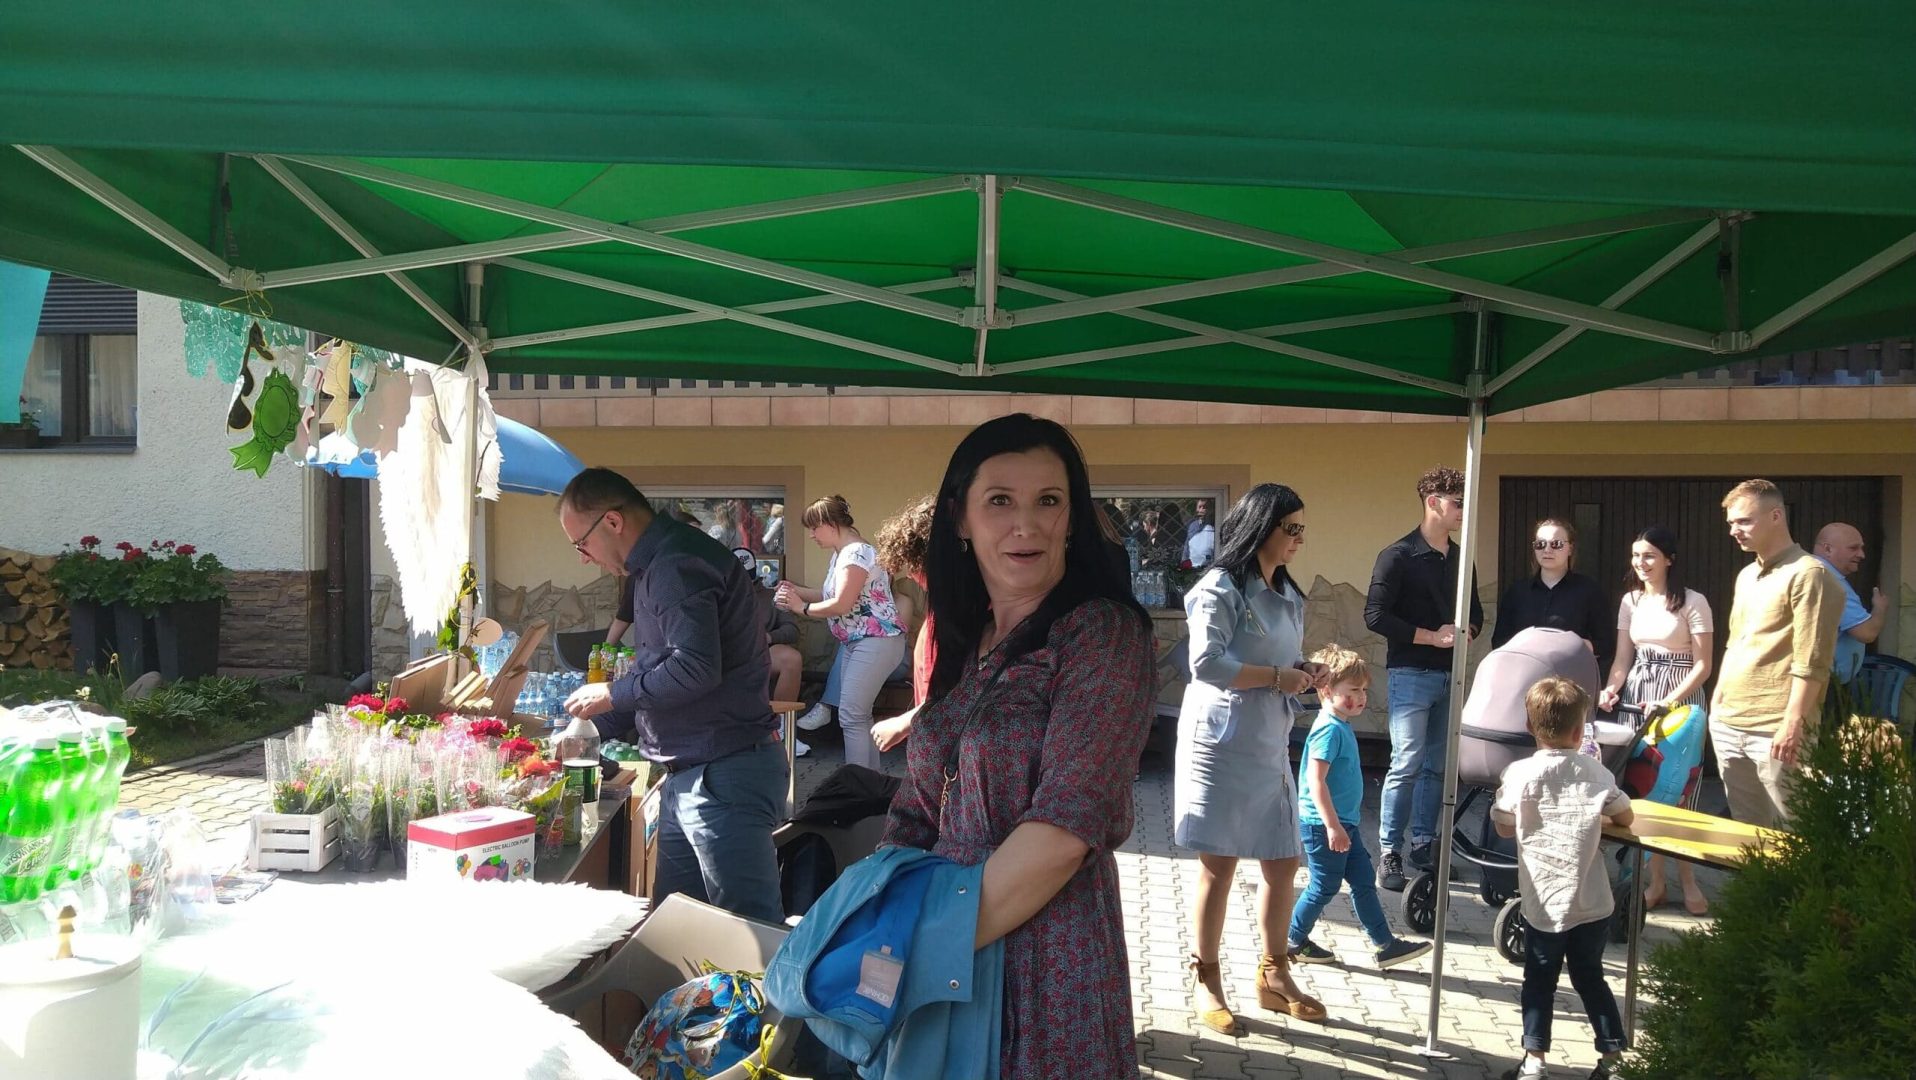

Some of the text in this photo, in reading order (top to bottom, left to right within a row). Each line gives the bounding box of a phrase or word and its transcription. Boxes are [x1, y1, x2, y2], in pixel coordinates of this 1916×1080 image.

[482, 837, 530, 853] ELECTRIC BALLOON PUMP
